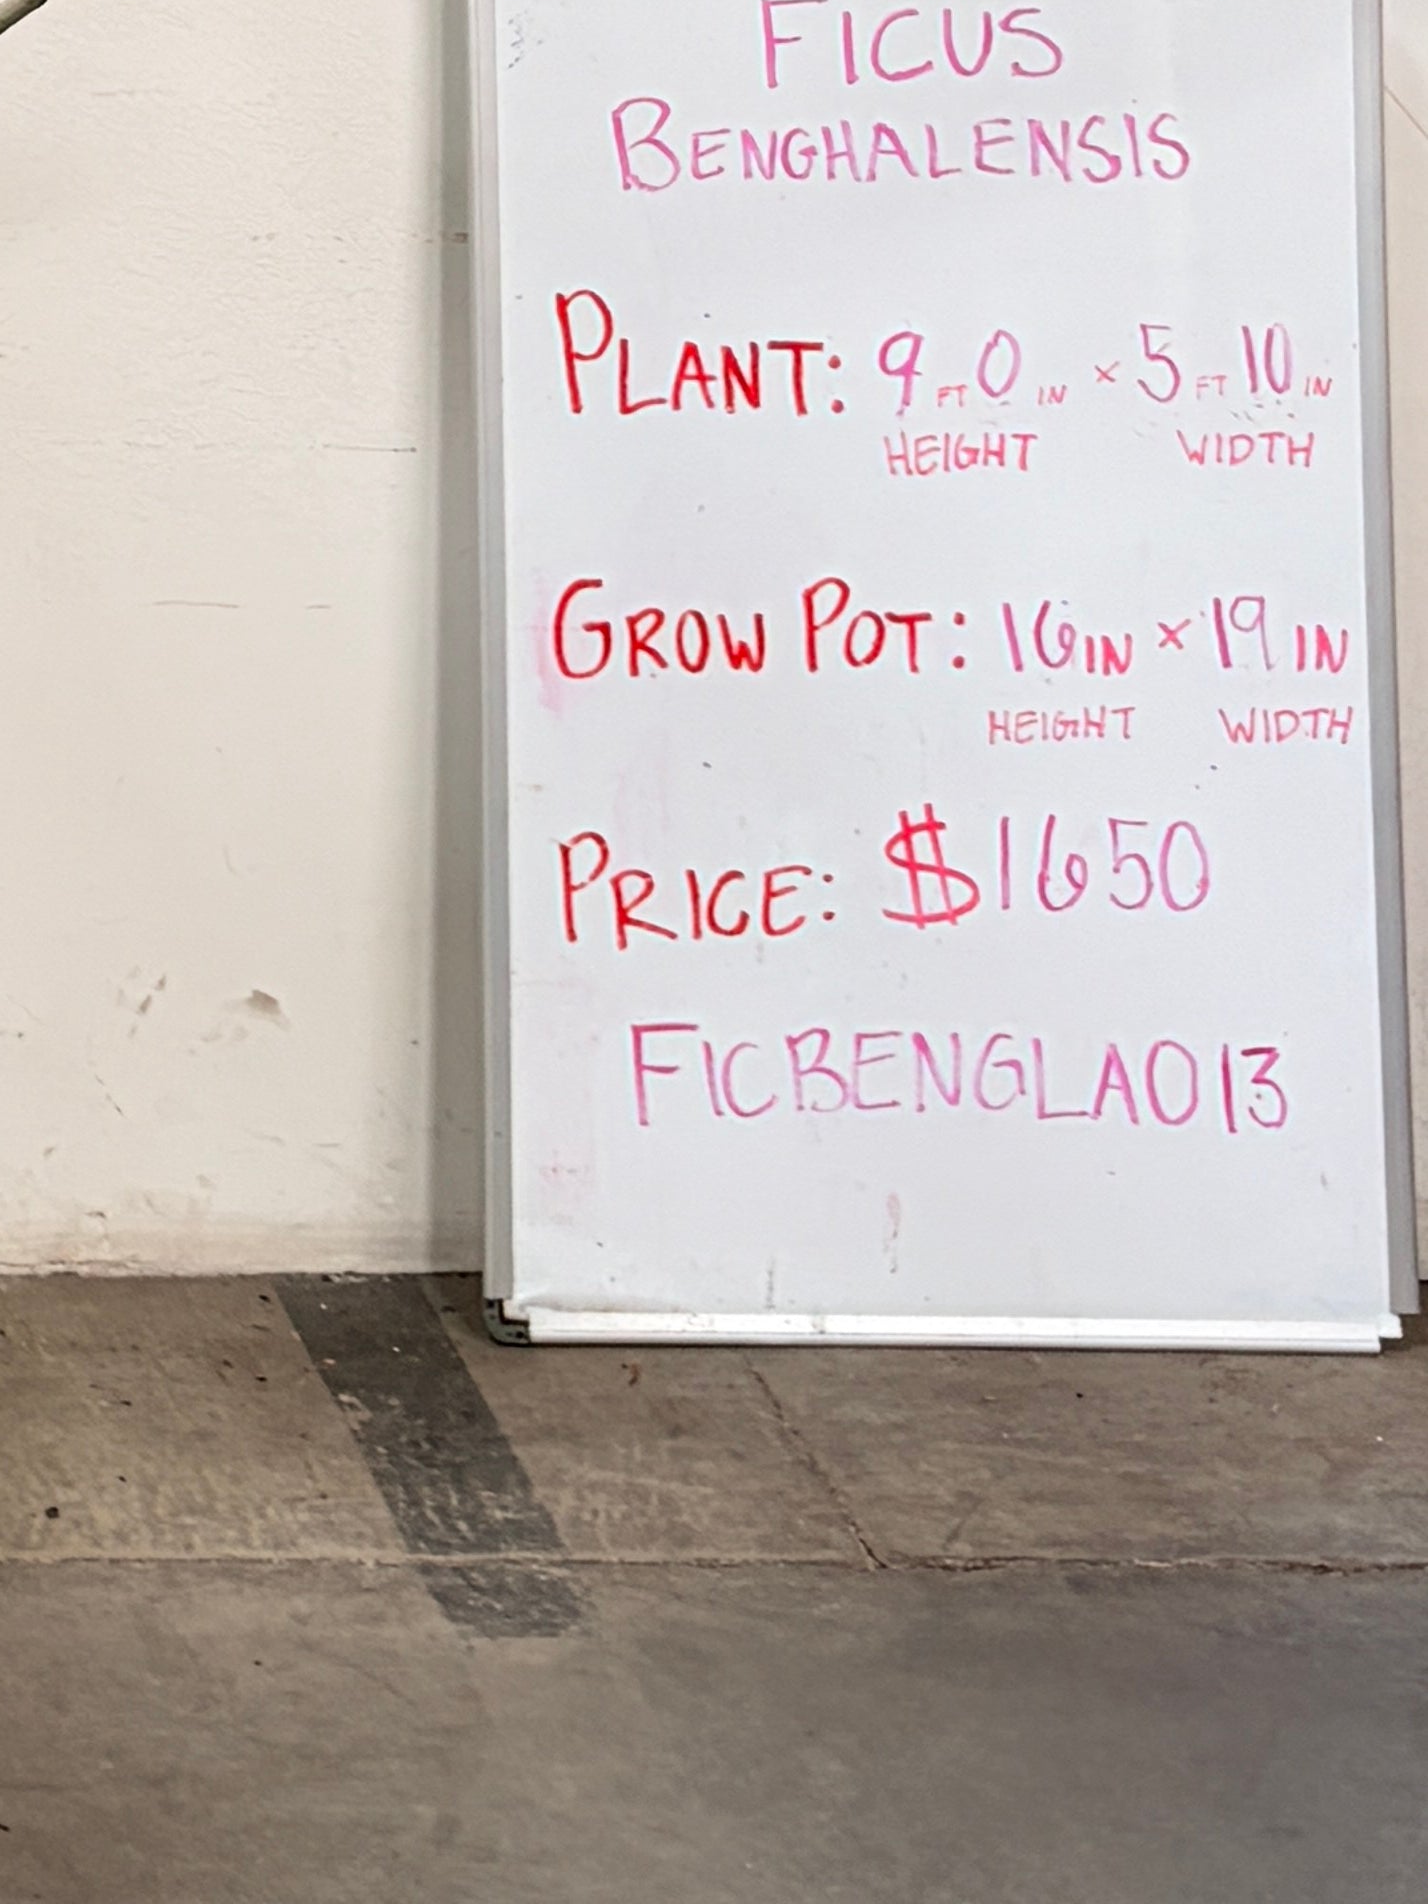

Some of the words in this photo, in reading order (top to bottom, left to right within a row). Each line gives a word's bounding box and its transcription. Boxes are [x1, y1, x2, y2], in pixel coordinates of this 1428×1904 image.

[610, 97, 1191, 193] BENGHALENSIS
[553, 288, 845, 418] PLANT:
[883, 432, 1038, 477] HEIGHT
[1176, 431, 1315, 468] WIDTH
[550, 577, 768, 682] GROW
[799, 576, 967, 676] POT:
[1211, 595, 1268, 671] 19
[986, 706, 1134, 746] HEIGHT
[1218, 707, 1354, 745] WIDTH
[557, 831, 836, 953] PRICE:
[882, 801, 1211, 931] $1650
